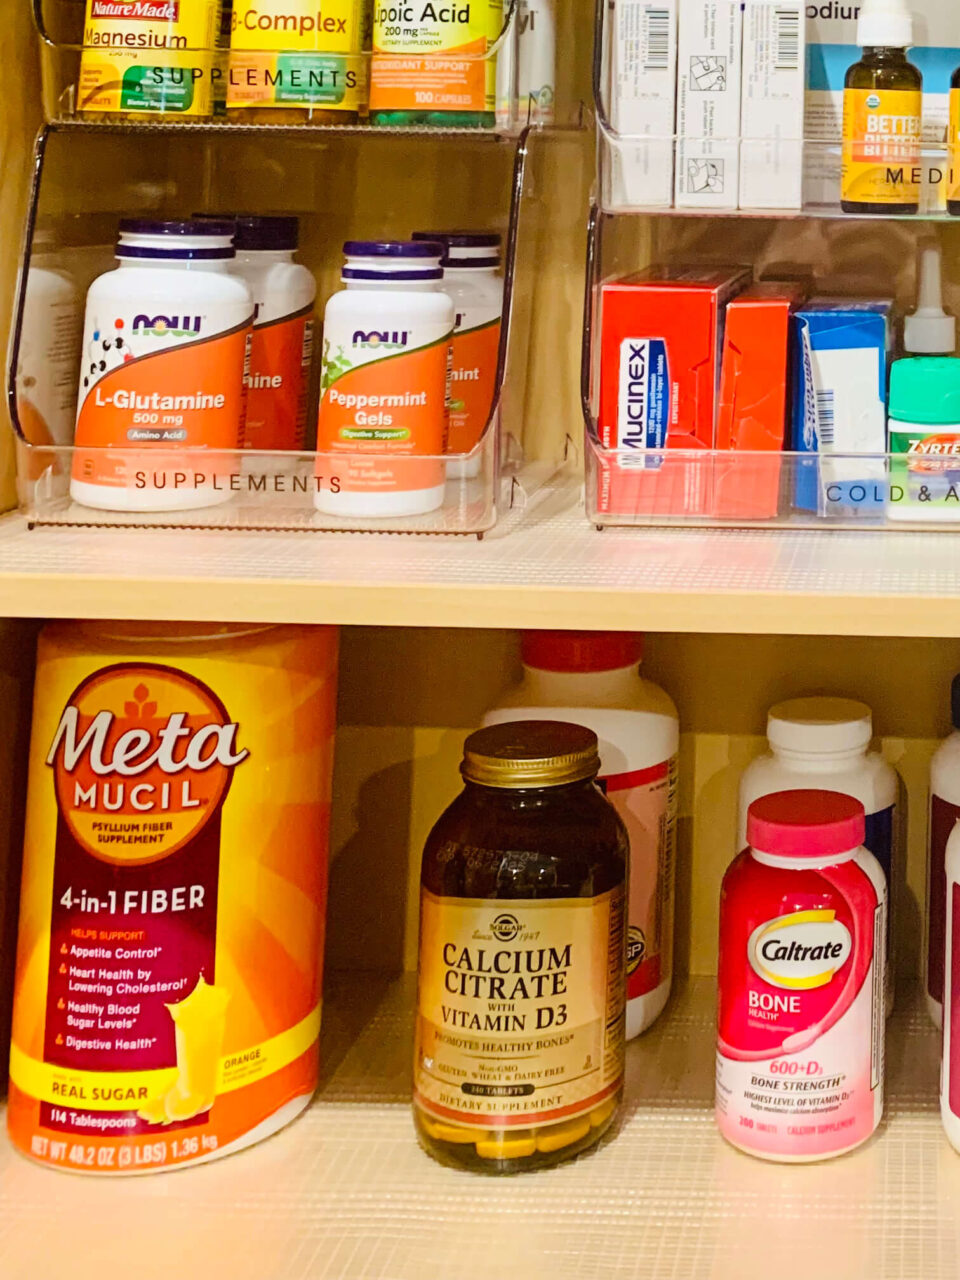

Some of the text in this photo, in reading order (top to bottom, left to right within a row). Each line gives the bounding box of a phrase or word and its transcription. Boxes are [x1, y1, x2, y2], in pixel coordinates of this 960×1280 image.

[419, 3, 470, 24] Acid
[385, 26, 418, 37] 200 mg
[152, 66, 357, 89] SUPPLEMENTS
[414, 91, 434, 103] 100
[95, 388, 225, 410] L-Glutamine
[329, 389, 427, 409] Peppermint
[133, 413, 183, 425] 500 mg
[354, 412, 393, 426] Gels
[131, 431, 183, 440] Amino Acid
[135, 471, 342, 494] SUPPLEMENTS
[826, 485, 904, 502] COLD
[918, 486, 931, 502] &
[45, 705, 250, 776] Meta
[73, 780, 200, 811] MUCIL
[92, 821, 173, 833] PSYLLIUM FIBER
[98, 833, 165, 844] SUPPLEMENT
[60, 884, 205, 915] 4-in-1 FIBER
[71, 928, 145, 942] HELPS SUPPORT
[70, 945, 113, 959] Appetite
[443, 943, 572, 974] CALCIUM
[761, 939, 843, 962] Caltrate
[69, 967, 151, 982] Heart Health by
[69, 979, 113, 995] Lowering
[444, 971, 567, 1000] CITRATE
[67, 1001, 140, 1016] Healthy Blood
[487, 1003, 515, 1012] WITH
[748, 990, 800, 1013] BONE
[67, 1016, 95, 1030] Sugar
[441, 1004, 567, 1032] VITAMIN D3
[66, 1036, 112, 1050] Digestive
[482, 1043, 533, 1052] HEALTHY
[224, 1049, 261, 1069] ORANGE
[751, 1075, 781, 1090] BONE
[52, 1082, 148, 1100] REAL SUGAR
[744, 1091, 840, 1106] HIGHEST LEVEL VITAMIN
[51, 1110, 136, 1130] 114 Tablespoons
[50, 1141, 68, 1160] WT
[98, 1147, 115, 1164] OZ
[172, 1138, 198, 1157] 1.36
